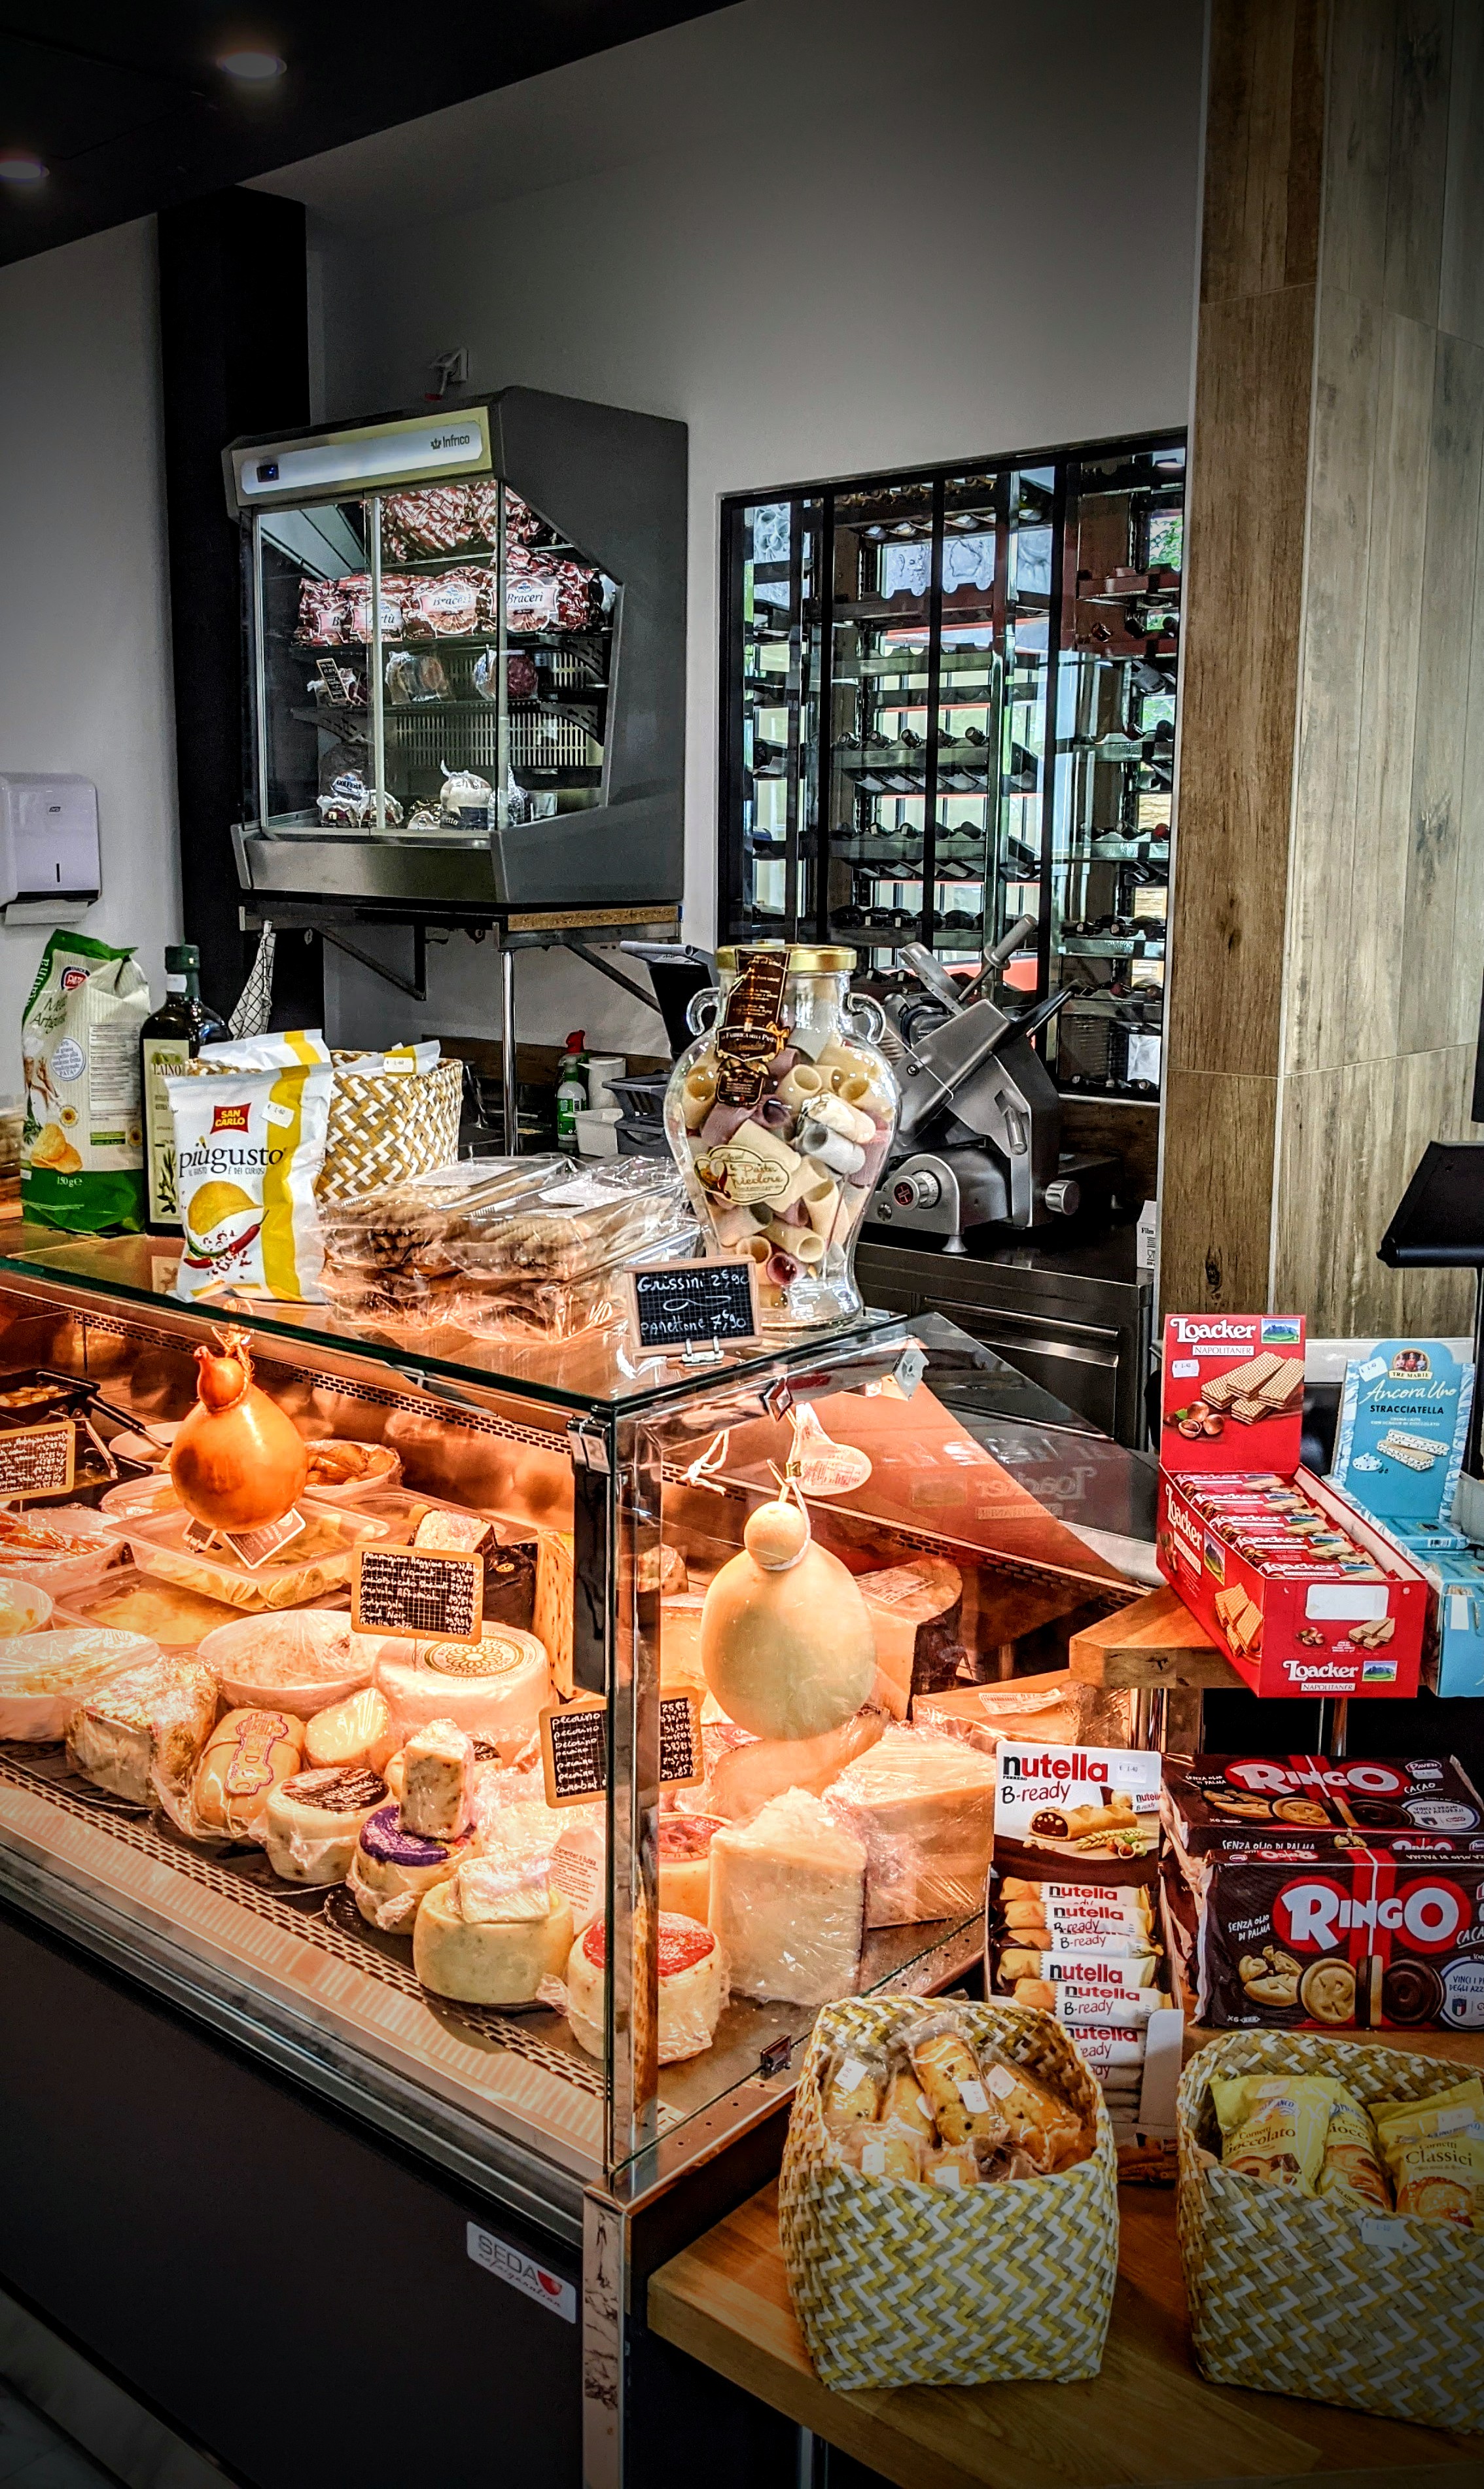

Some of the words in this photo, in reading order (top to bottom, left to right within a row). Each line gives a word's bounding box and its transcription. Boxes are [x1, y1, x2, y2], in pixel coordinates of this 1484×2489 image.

[442, 434, 470, 448] Infrico
[215, 1117, 246, 1127] CARLO
[221, 1109, 241, 1119] SAN
[637, 1272, 706, 1293] Grissini
[1170, 1318, 1257, 1343] Loacker
[1358, 1379, 1426, 1404] Ancora
[1427, 1380, 1458, 1400] Uno
[1369, 1404, 1444, 1415] STRACCIATELLA
[1174, 1474, 1239, 1486] Loacker
[1191, 1492, 1261, 1506] Loacker
[1165, 1483, 1203, 1551] Loacker
[1209, 1514, 1281, 1528] Loacker
[1233, 1535, 1305, 1549] Loacker
[1258, 1561, 1336, 1574] Loacker
[1282, 1660, 1360, 1682] Loacker
[1003, 1753, 1108, 1783] nutella
[1229, 1763, 1400, 1794] RINGO
[1000, 1780, 1072, 1805] B-ready
[1404, 1782, 1436, 1794] CACAO
[1222, 1839, 1250, 1850] SENZA
[1252, 1841, 1273, 1850] OLIO
[1049, 1885, 1118, 1901] nutella
[1053, 1907, 1124, 1921] nutella
[1281, 1884, 1459, 1951] RINGO
[1053, 1918, 1100, 1932] B-ready
[1228, 1918, 1252, 1933] SENZA
[1254, 1914, 1269, 1925] OLIO
[1238, 1932, 1246, 1942] DI
[1248, 1922, 1271, 1939] PALMA
[1059, 1935, 1106, 1949] B-ready
[1457, 1926, 1484, 1945] CACA
[1050, 1963, 1123, 1984] nutella
[1453, 1975, 1472, 1983] VINCI
[1065, 1985, 1140, 2002] nutella
[1449, 1984, 1468, 1992] DEGLI
[1063, 1999, 1114, 2016] B-ready
[1066, 2026, 1139, 2043] nutella
[1080, 2041, 1112, 2059] ready
[1227, 2128, 1296, 2154] ioccolato
[1419, 2140, 1457, 2150] Cornetti
[1405, 2150, 1472, 2167] Classici
[478, 2234, 540, 2286] SEDA
